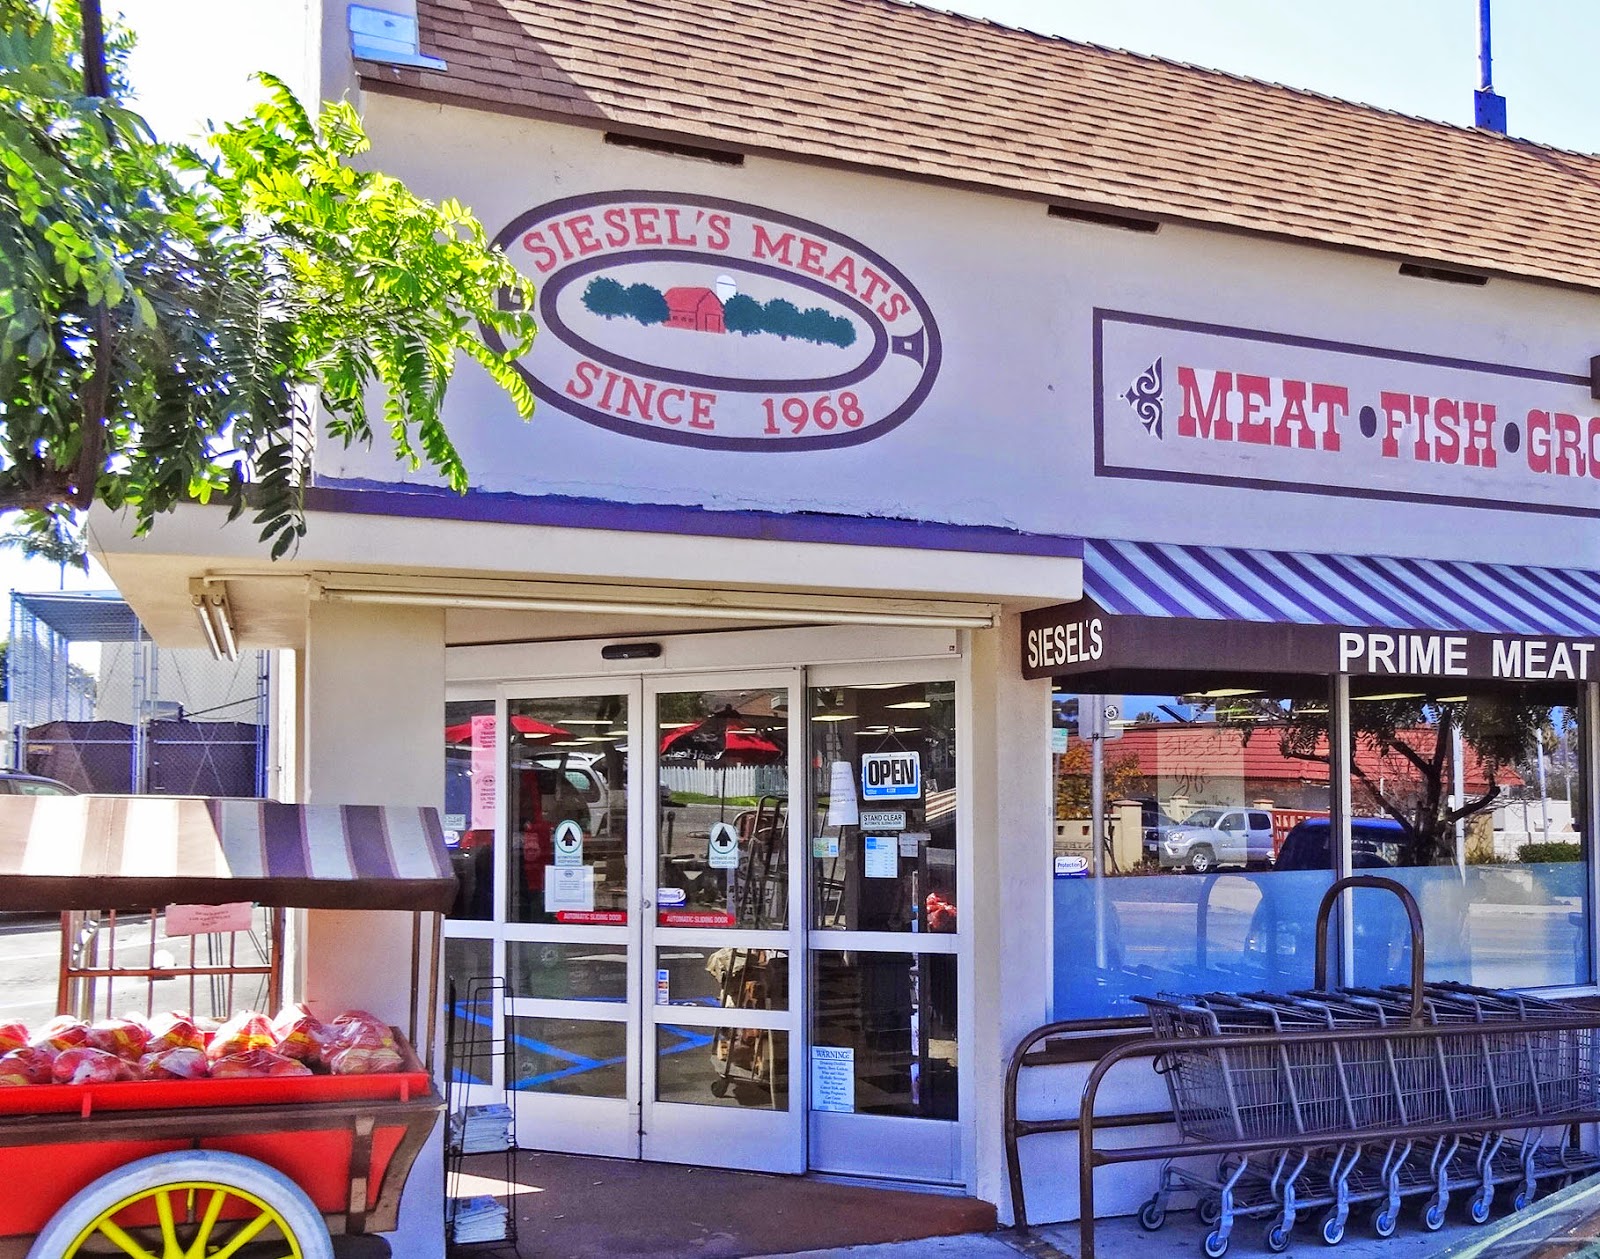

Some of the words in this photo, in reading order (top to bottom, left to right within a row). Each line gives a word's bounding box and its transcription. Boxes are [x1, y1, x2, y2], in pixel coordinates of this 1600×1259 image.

[523, 207, 731, 272] SIESEL'S
[752, 224, 911, 323] MEATS
[564, 361, 717, 430] SINCE
[762, 391, 865, 435] 1968
[1178, 366, 1349, 452] MEAT
[1380, 391, 1497, 468] FISH
[1028, 618, 1103, 669] SIESEL'S
[1339, 632, 1468, 676] PRIME
[1492, 640, 1595, 681] MEAT
[868, 759, 915, 786] OPEN
[864, 814, 883, 822] STAND
[883, 814, 902, 822] CLEAR
